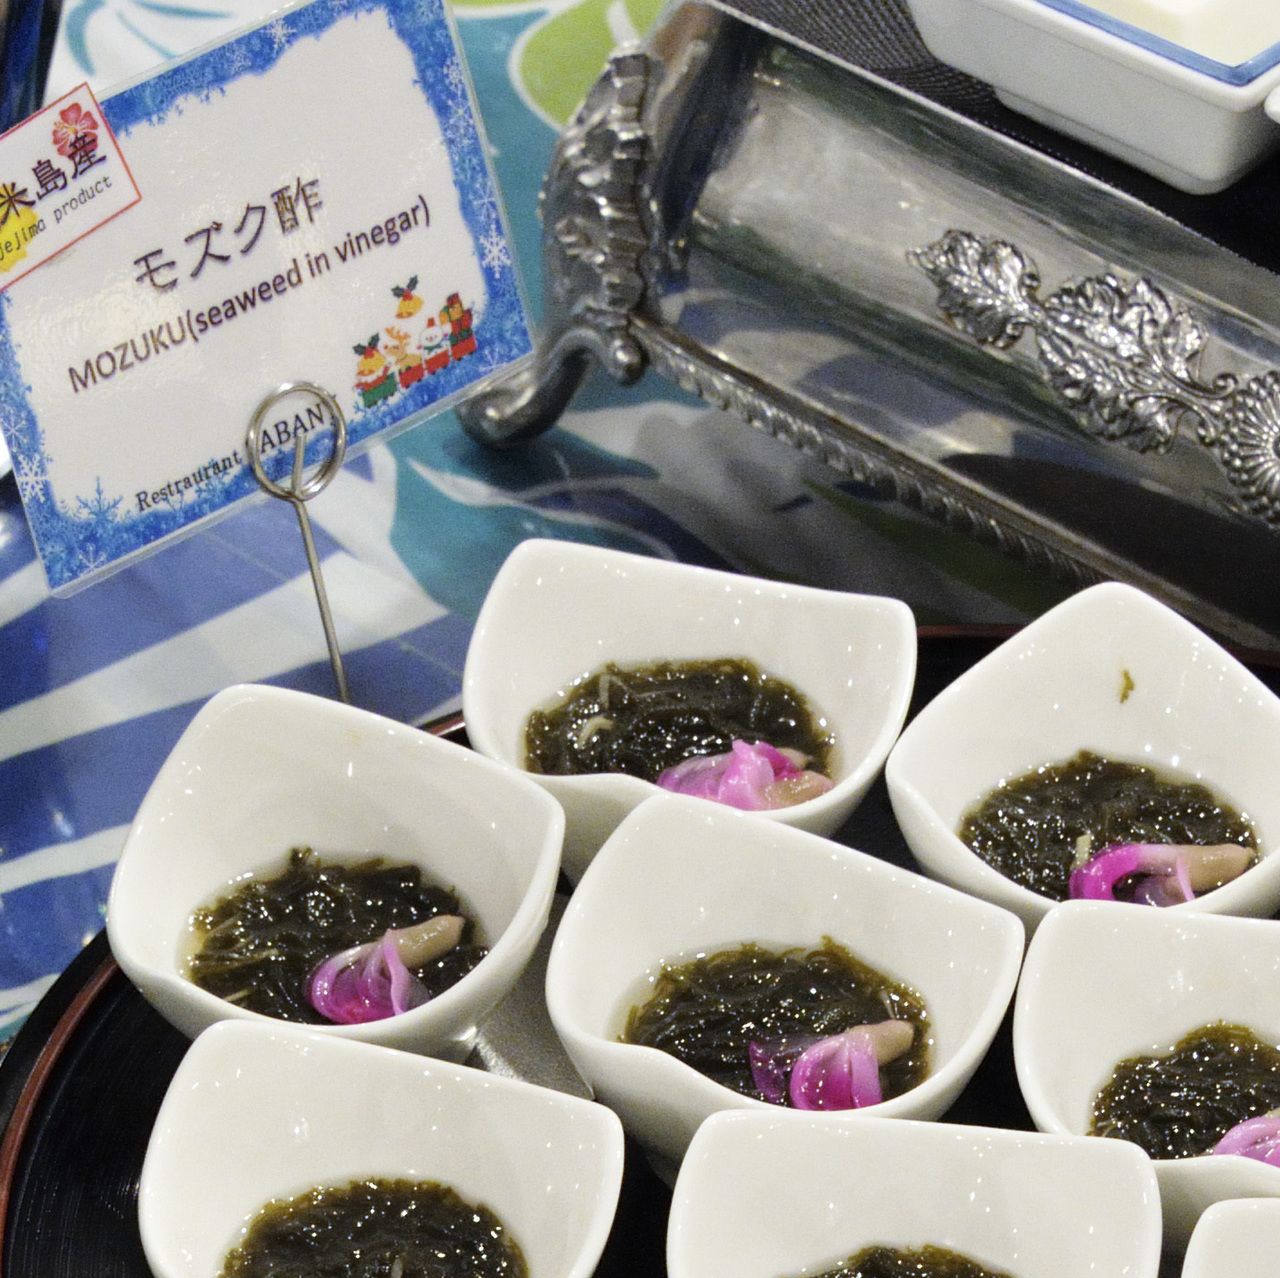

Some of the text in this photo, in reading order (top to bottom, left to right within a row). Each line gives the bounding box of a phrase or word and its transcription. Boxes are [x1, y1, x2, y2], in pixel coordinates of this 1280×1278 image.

[53, 174, 113, 224] product
[133, 176, 323, 291] モズク酢
[69, 194, 431, 393] MOZUKU(seaweed in vinegar)
[135, 449, 242, 512] Restraurant
